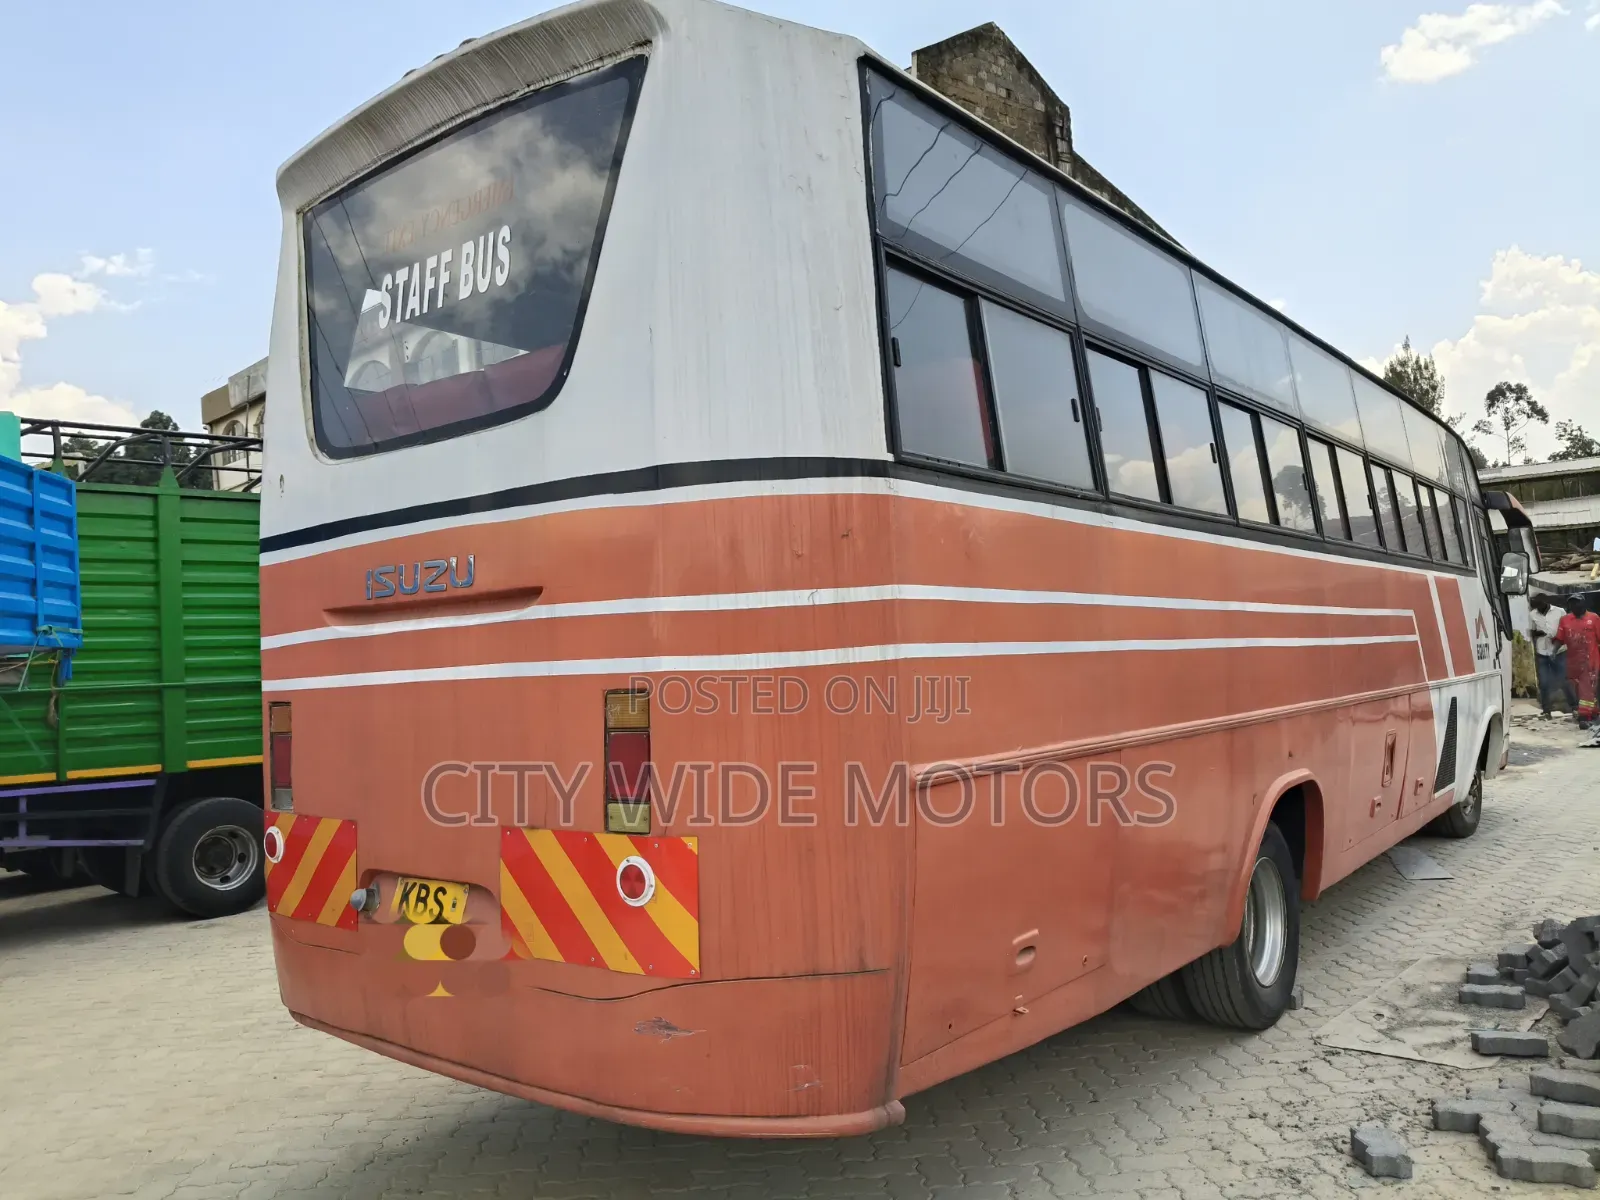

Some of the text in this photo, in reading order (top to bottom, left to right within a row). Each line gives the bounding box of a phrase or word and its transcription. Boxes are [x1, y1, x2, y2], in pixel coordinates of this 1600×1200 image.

[378, 224, 512, 329] STAFF BUS
[365, 554, 476, 600] ISUZU
[397, 882, 447, 919] KBS
